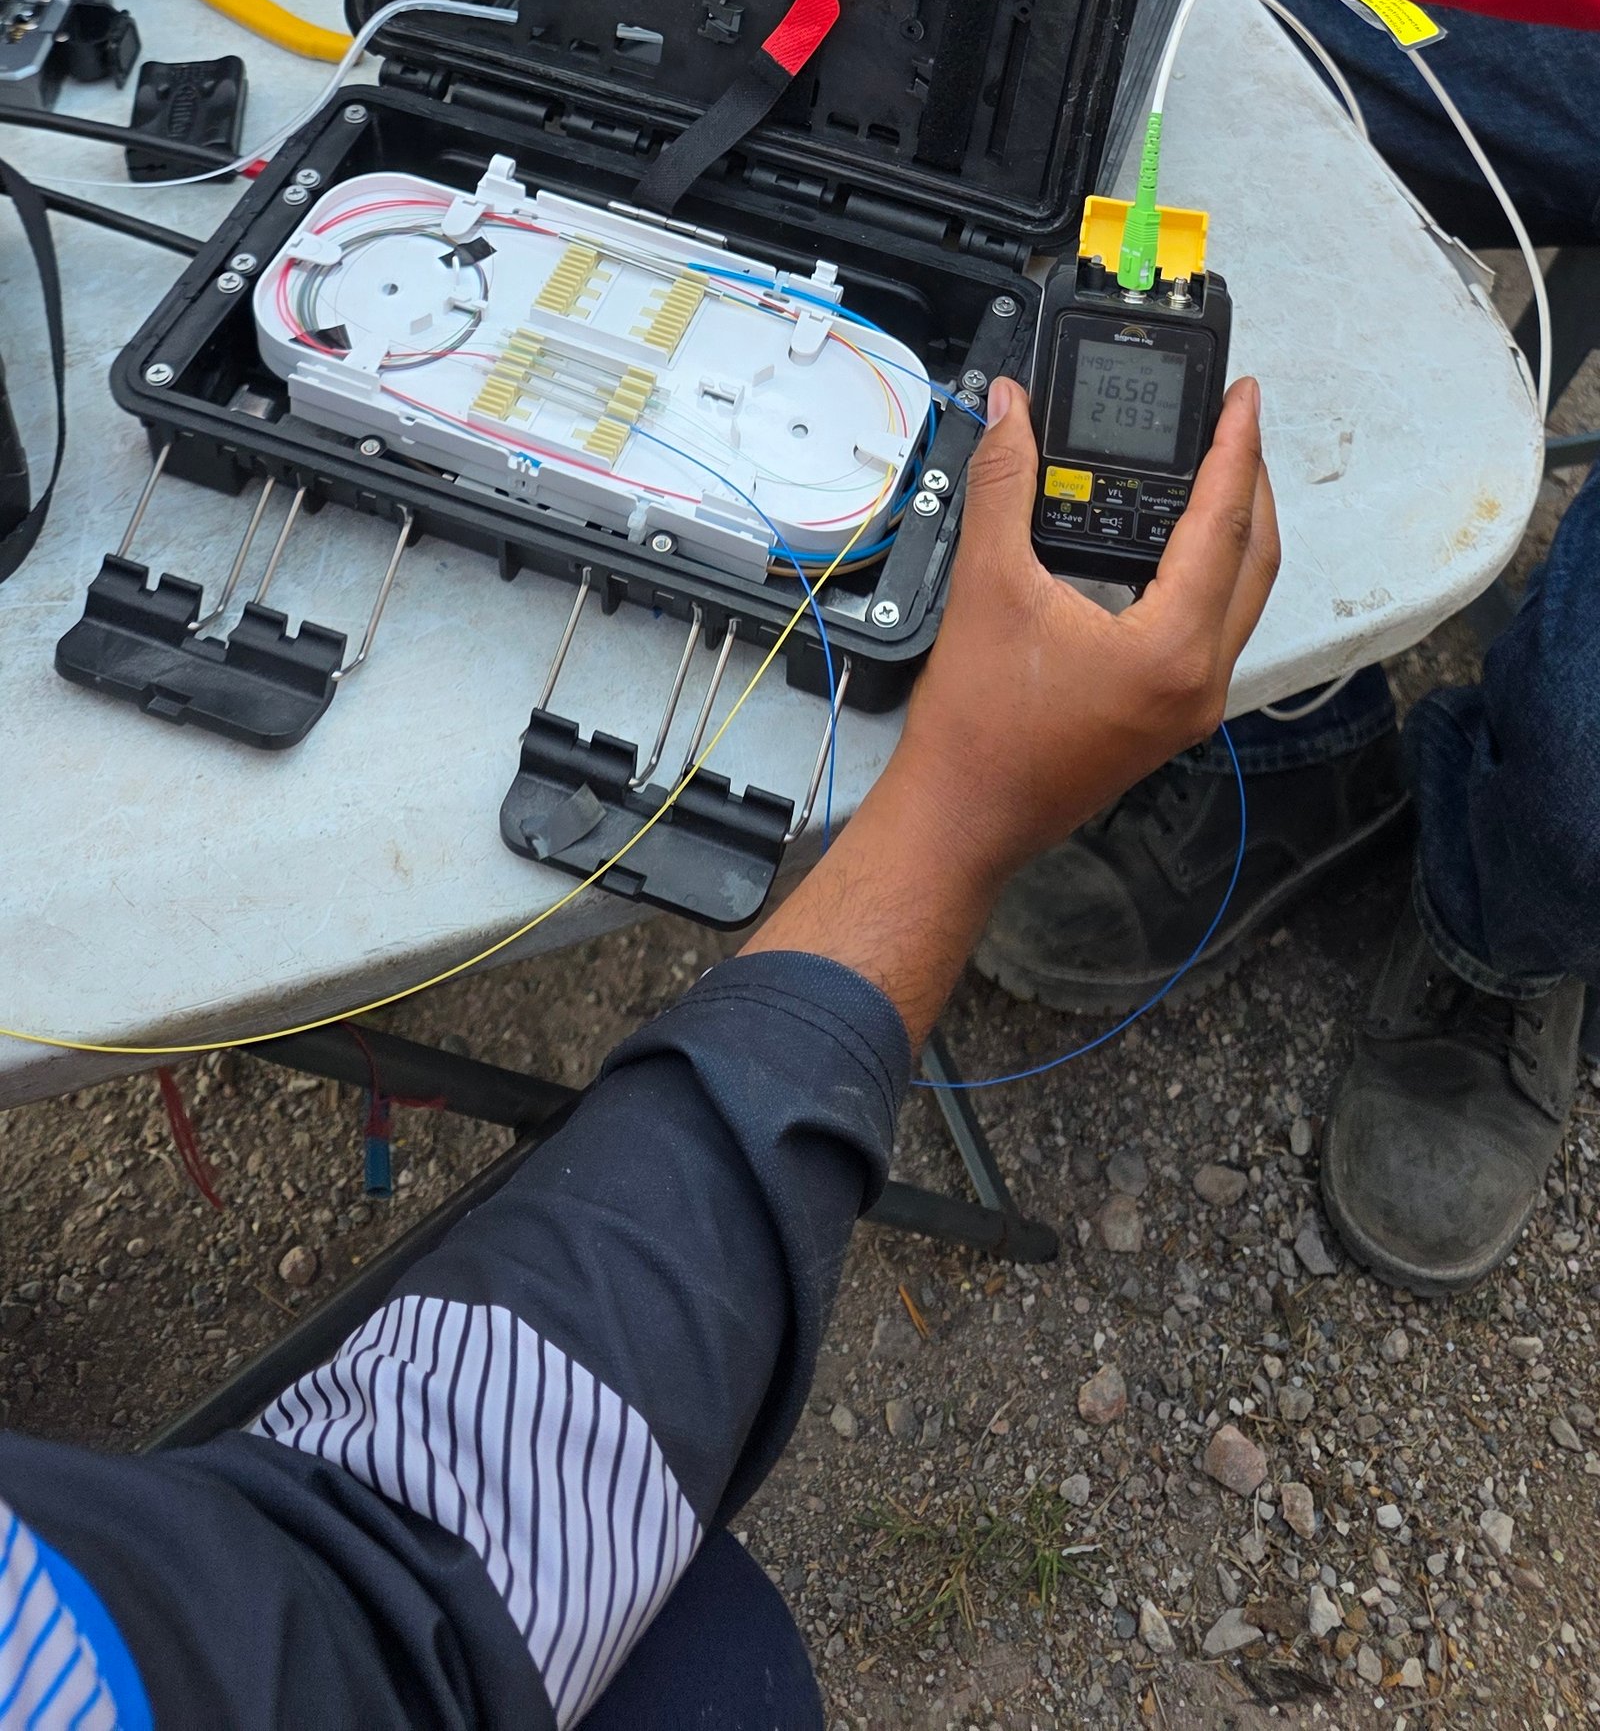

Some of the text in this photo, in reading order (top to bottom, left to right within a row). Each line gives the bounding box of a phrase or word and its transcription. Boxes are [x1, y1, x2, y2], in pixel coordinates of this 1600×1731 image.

[1051, 480, 1085, 491] ON/OFF
[1107, 487, 1123, 498] VFL
[1141, 494, 1185, 507] Wavelength
[1062, 512, 1083, 523] Save
[1151, 526, 1166, 536] REF
